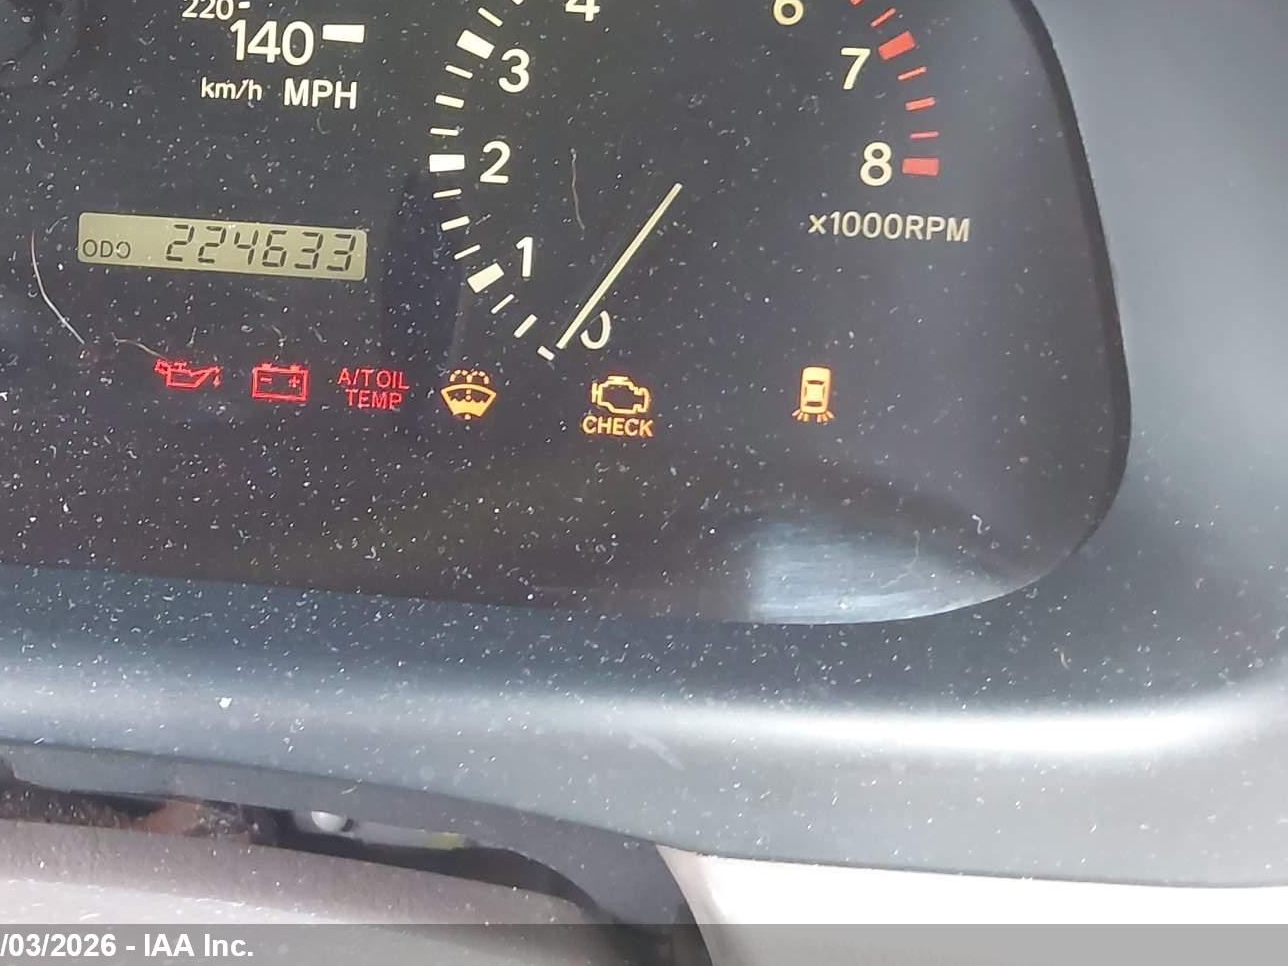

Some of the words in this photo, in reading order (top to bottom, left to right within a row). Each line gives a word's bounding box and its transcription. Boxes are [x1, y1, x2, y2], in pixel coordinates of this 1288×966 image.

[230, 19, 314, 66] 140
[498, 48, 530, 92] 3
[841, 46, 871, 90] 7
[200, 78, 263, 101] km/h
[283, 79, 357, 110] MPH
[481, 142, 510, 183] 2
[860, 142, 893, 185] 8
[82, 238, 131, 259] ODO
[165, 224, 357, 272] 224633
[516, 236, 534, 278] 1
[345, 389, 402, 409] TEMP
[582, 415, 653, 436] CHECK
